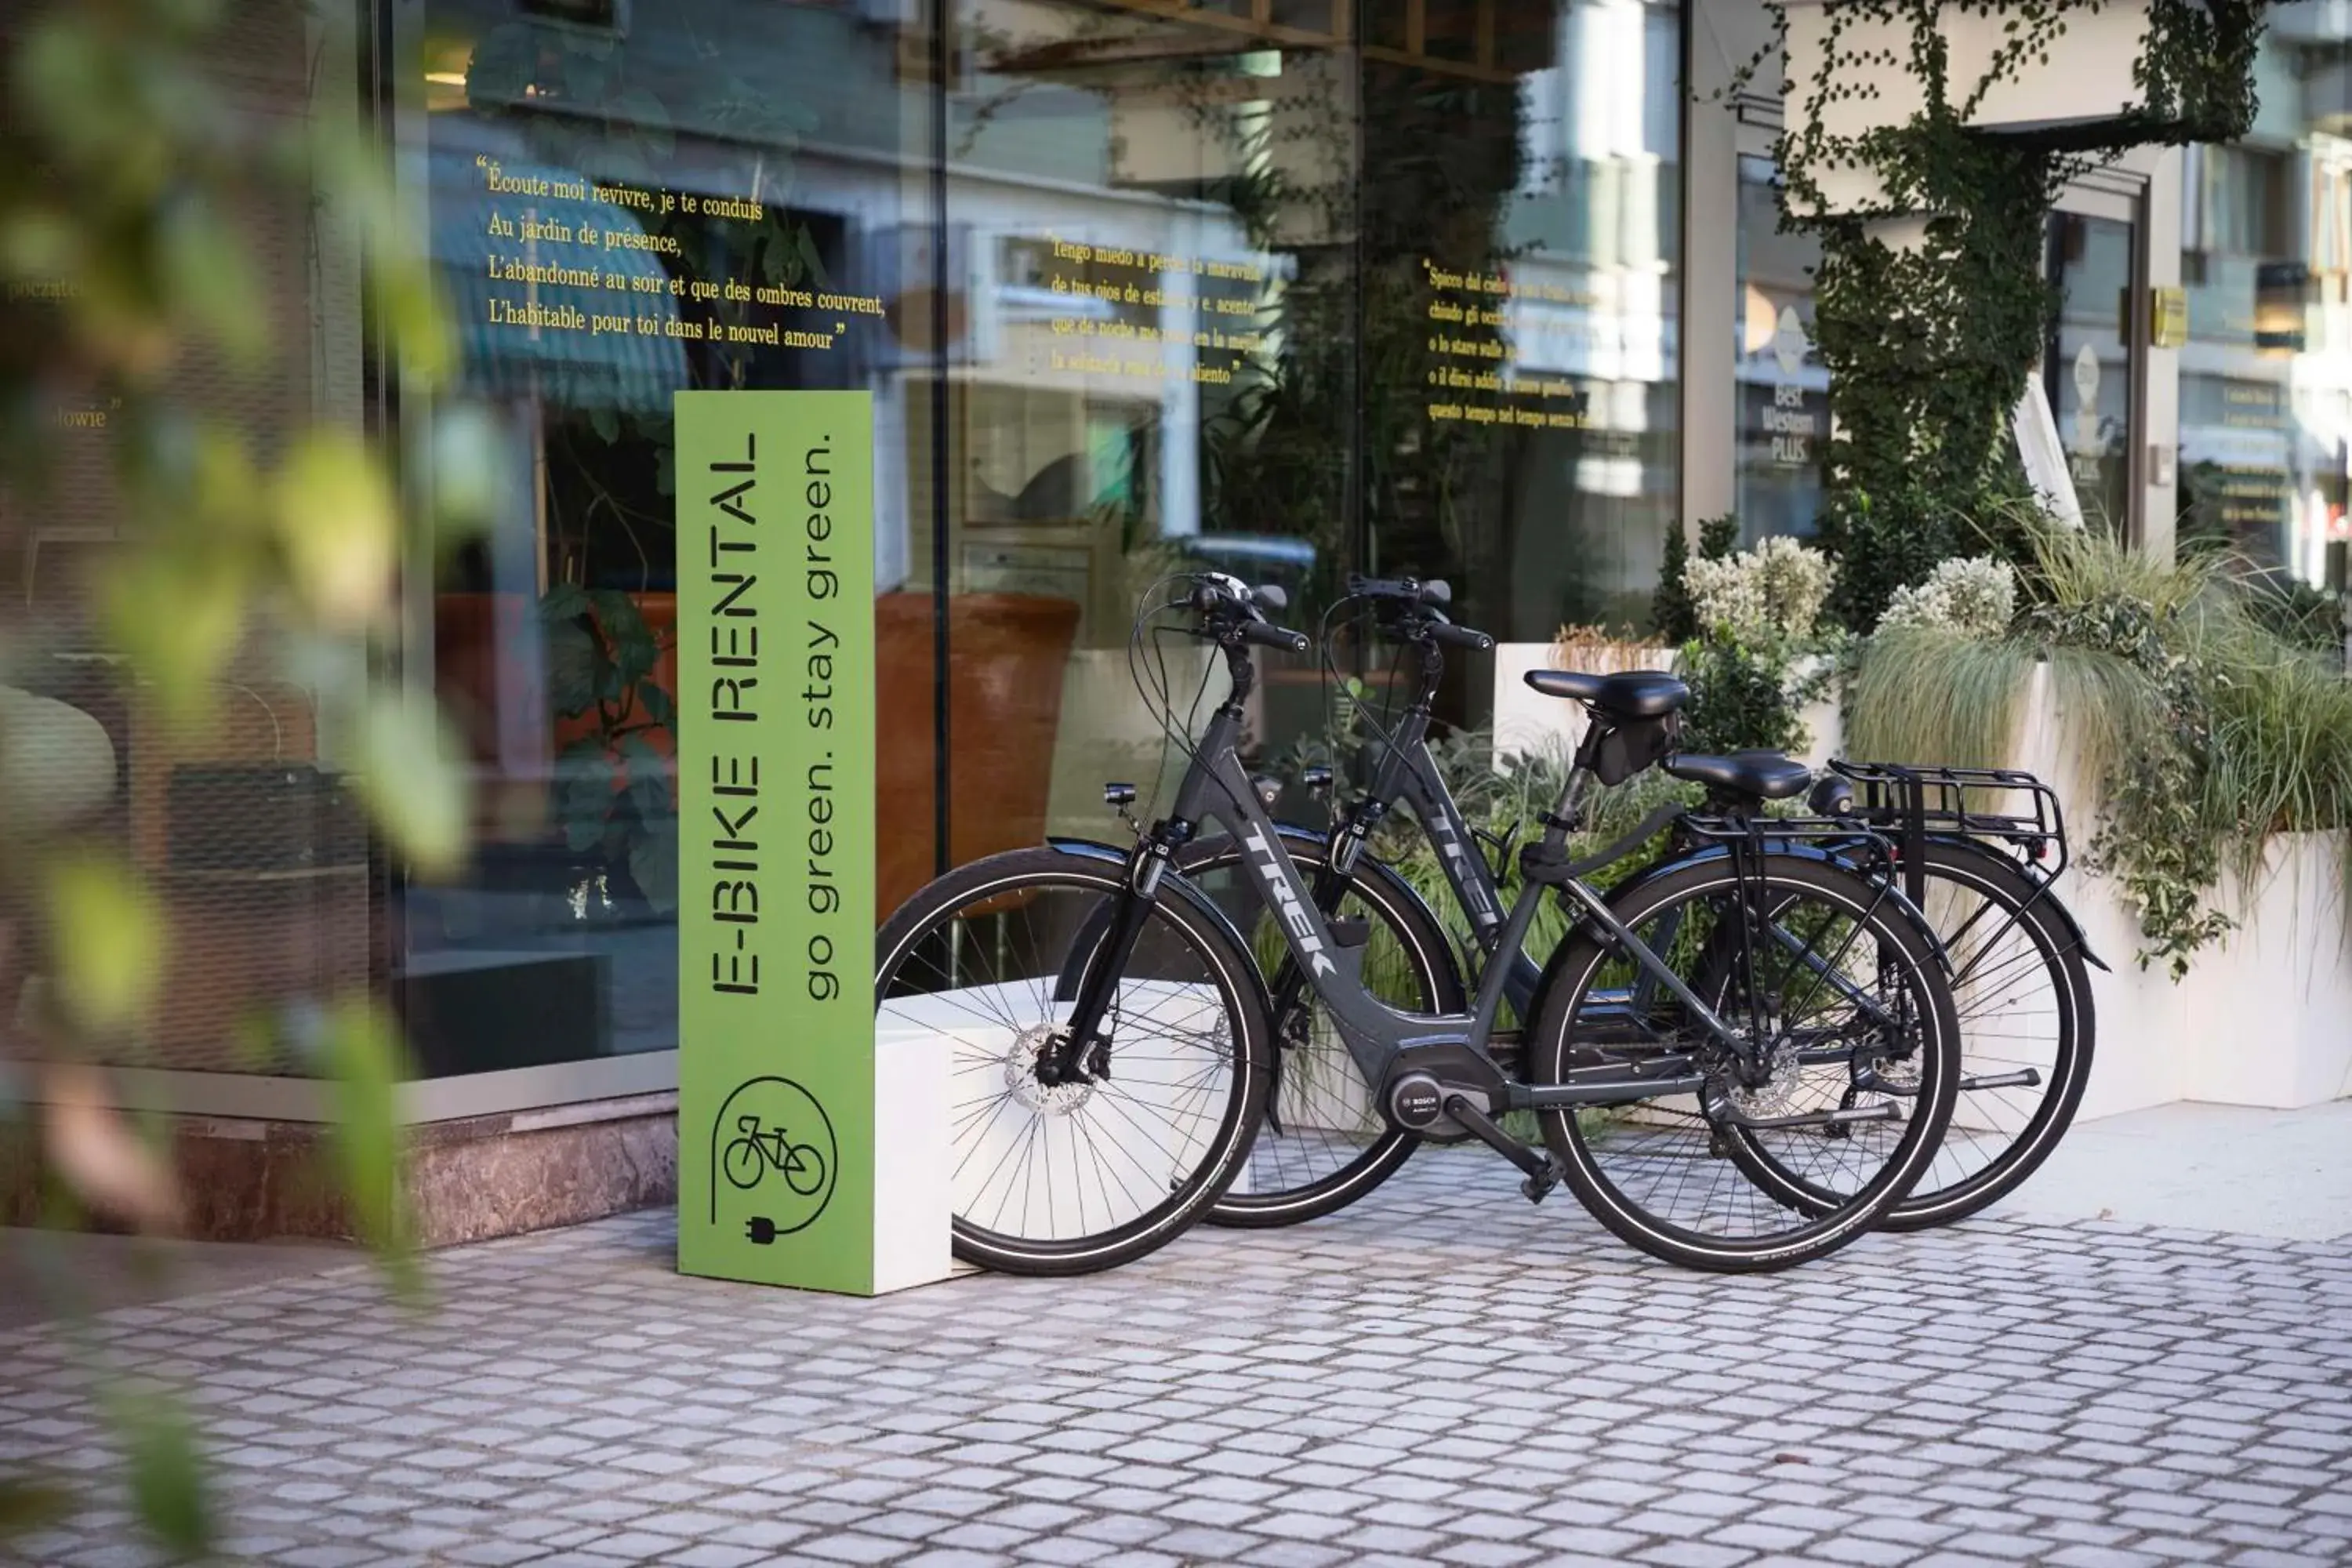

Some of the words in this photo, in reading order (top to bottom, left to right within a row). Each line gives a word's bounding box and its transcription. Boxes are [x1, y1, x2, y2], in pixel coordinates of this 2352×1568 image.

[554, 176, 585, 201] moi
[592, 182, 655, 212] revivre,
[660, 188, 675, 213] je
[681, 194, 697, 213] te
[703, 194, 763, 221] conduis
[488, 211, 514, 238] Au
[519, 215, 572, 243] jardin
[579, 221, 598, 245] de
[605, 225, 683, 257] présence,
[606, 271, 626, 291] au
[632, 270, 663, 294] soir
[669, 276, 685, 296] et
[690, 279, 720, 305] que
[725, 277, 751, 300] des
[757, 281, 812, 308] ombres
[818, 289, 886, 318] couvrent,
[1124, 283, 1139, 303] de
[591, 311, 630, 336] pour
[637, 312, 659, 336] toi
[665, 311, 702, 339] dans
[709, 314, 723, 341] le
[728, 316, 779, 346] nouvel
[1772, 436, 1807, 463] PLUS
[805, 434, 839, 600] green.
[711, 432, 757, 721] RENTAL
[801, 619, 839, 731] stay
[807, 753, 838, 921] green.
[712, 756, 758, 994] E-BIKE
[1245, 821, 1338, 978] TREK
[808, 934, 839, 1002] go
